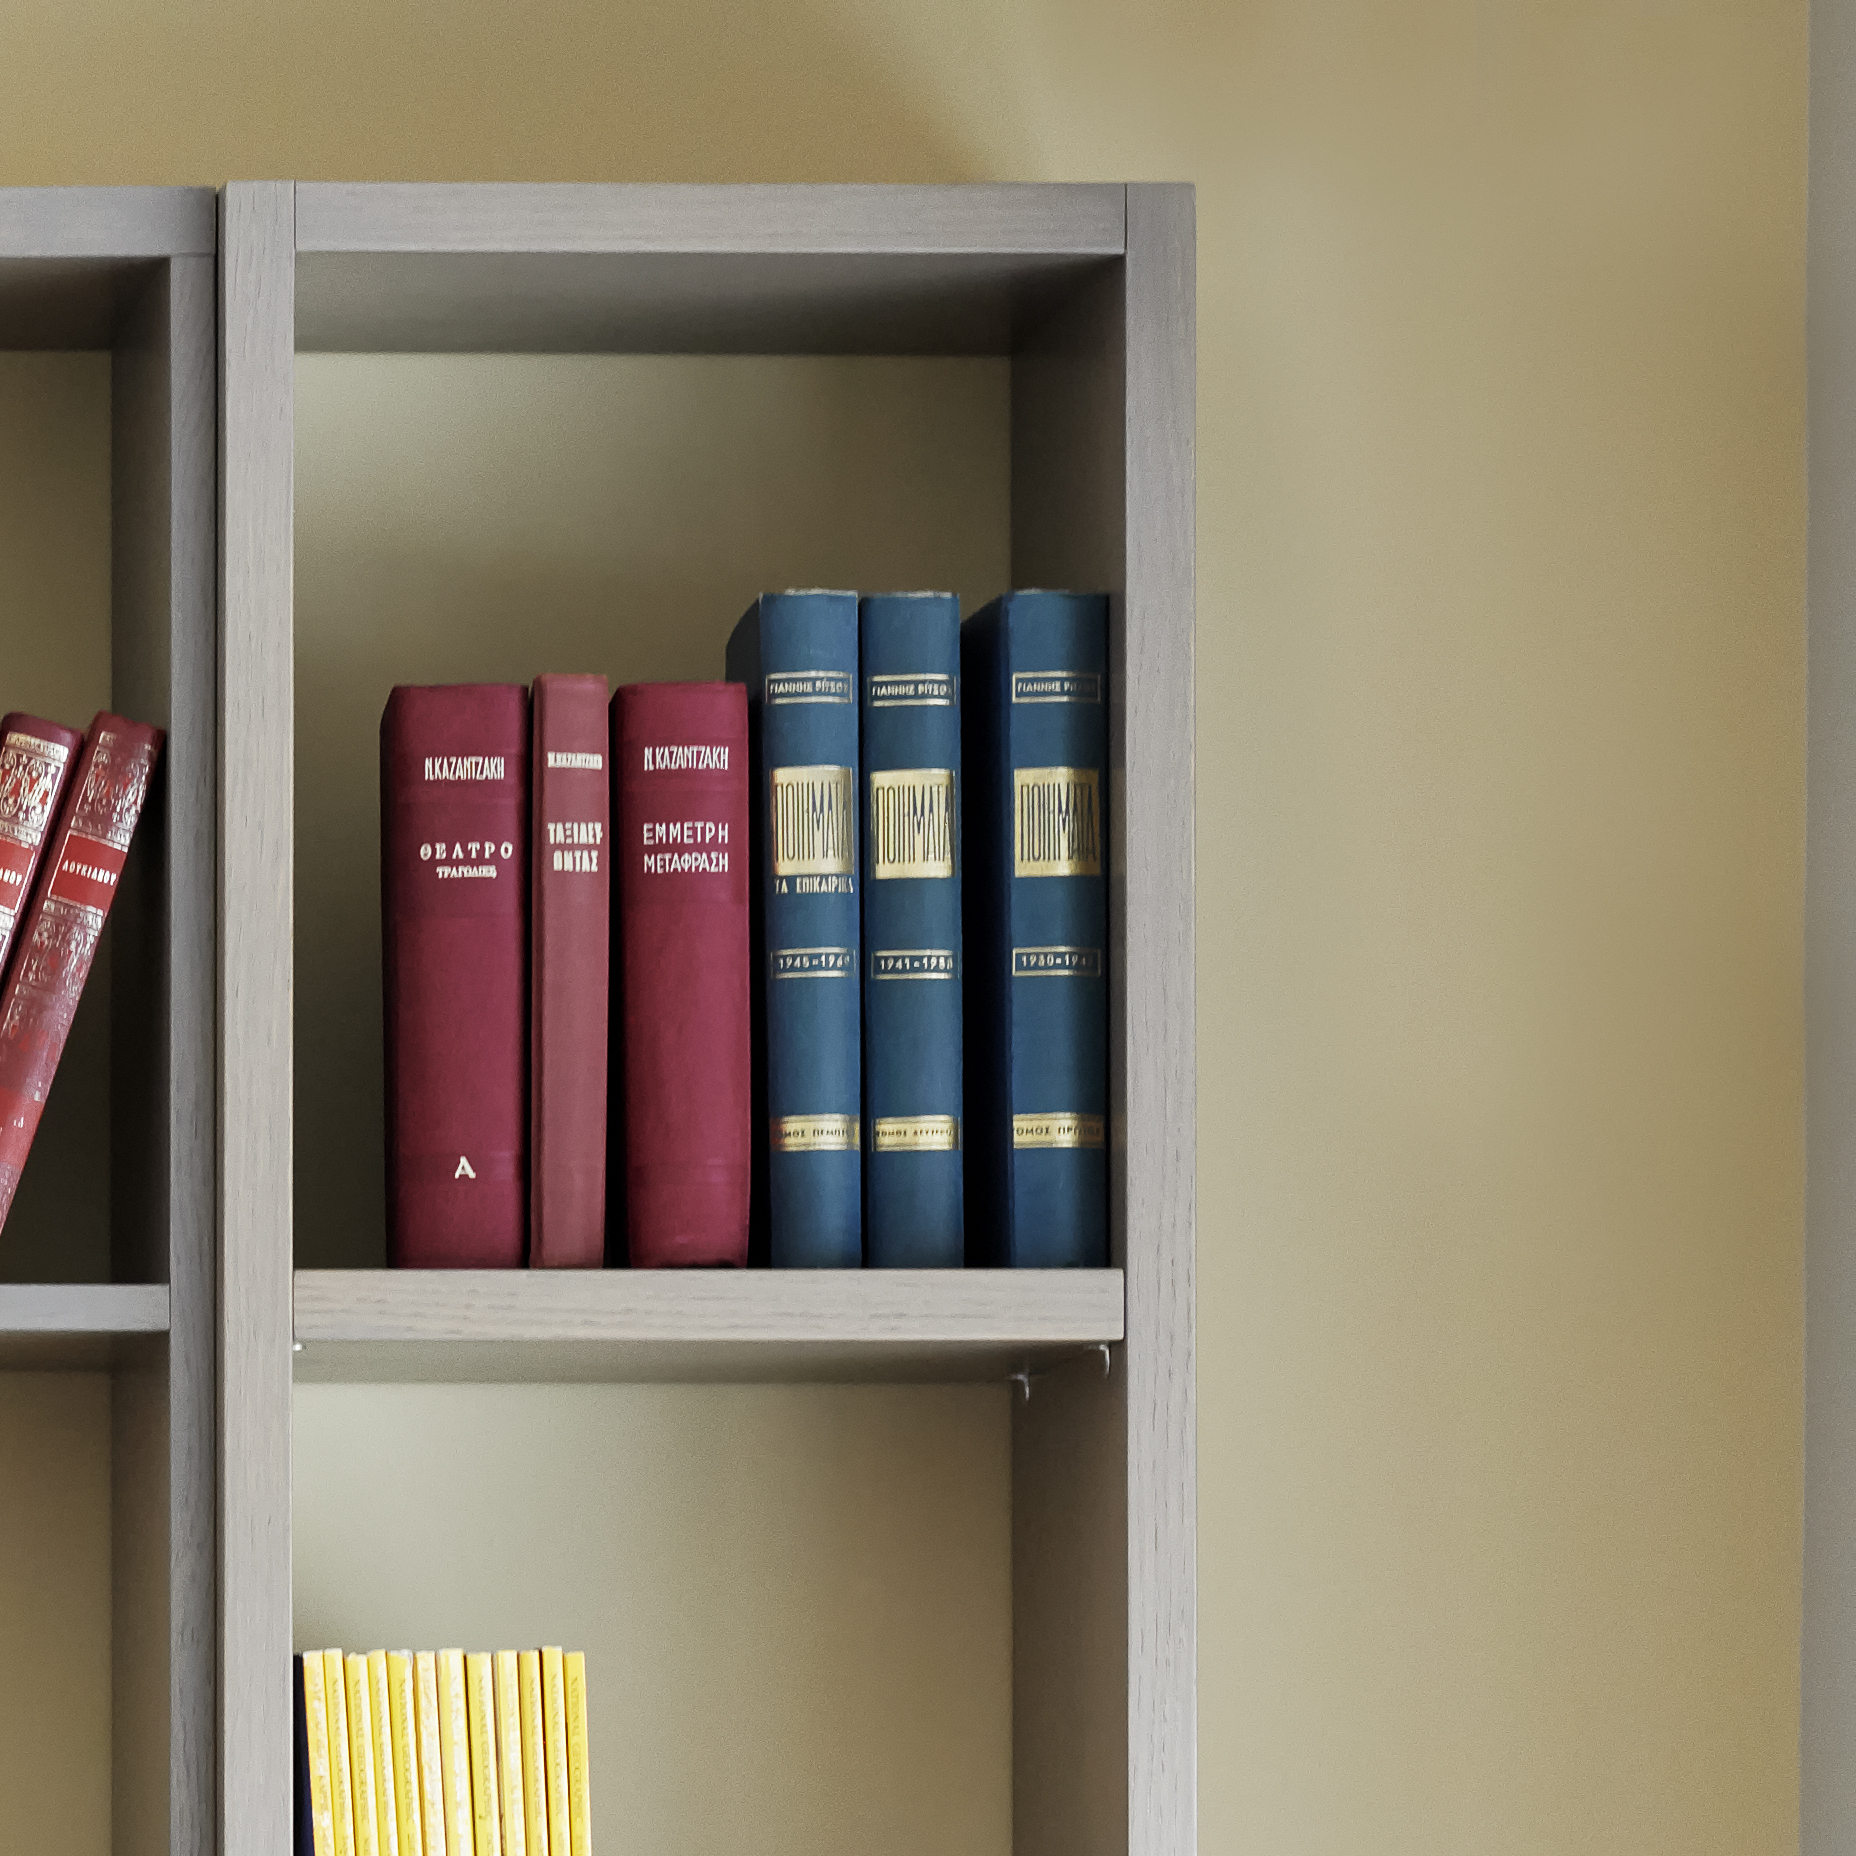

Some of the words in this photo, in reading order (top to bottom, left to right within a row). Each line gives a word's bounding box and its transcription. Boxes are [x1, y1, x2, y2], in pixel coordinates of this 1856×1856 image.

[643, 821, 730, 846] ΕΜΜΕΤΡΗ
[419, 842, 514, 861] ΘΕΑΤΡΟ
[553, 849, 599, 873] ΟΝΤΑΣ
[643, 852, 730, 874] ΜΕΤΑΦΡΑΣΗ
[62, 859, 117, 886] ΛΟΥΚΙΑΝΟΥ
[454, 1155, 476, 1180] Α
